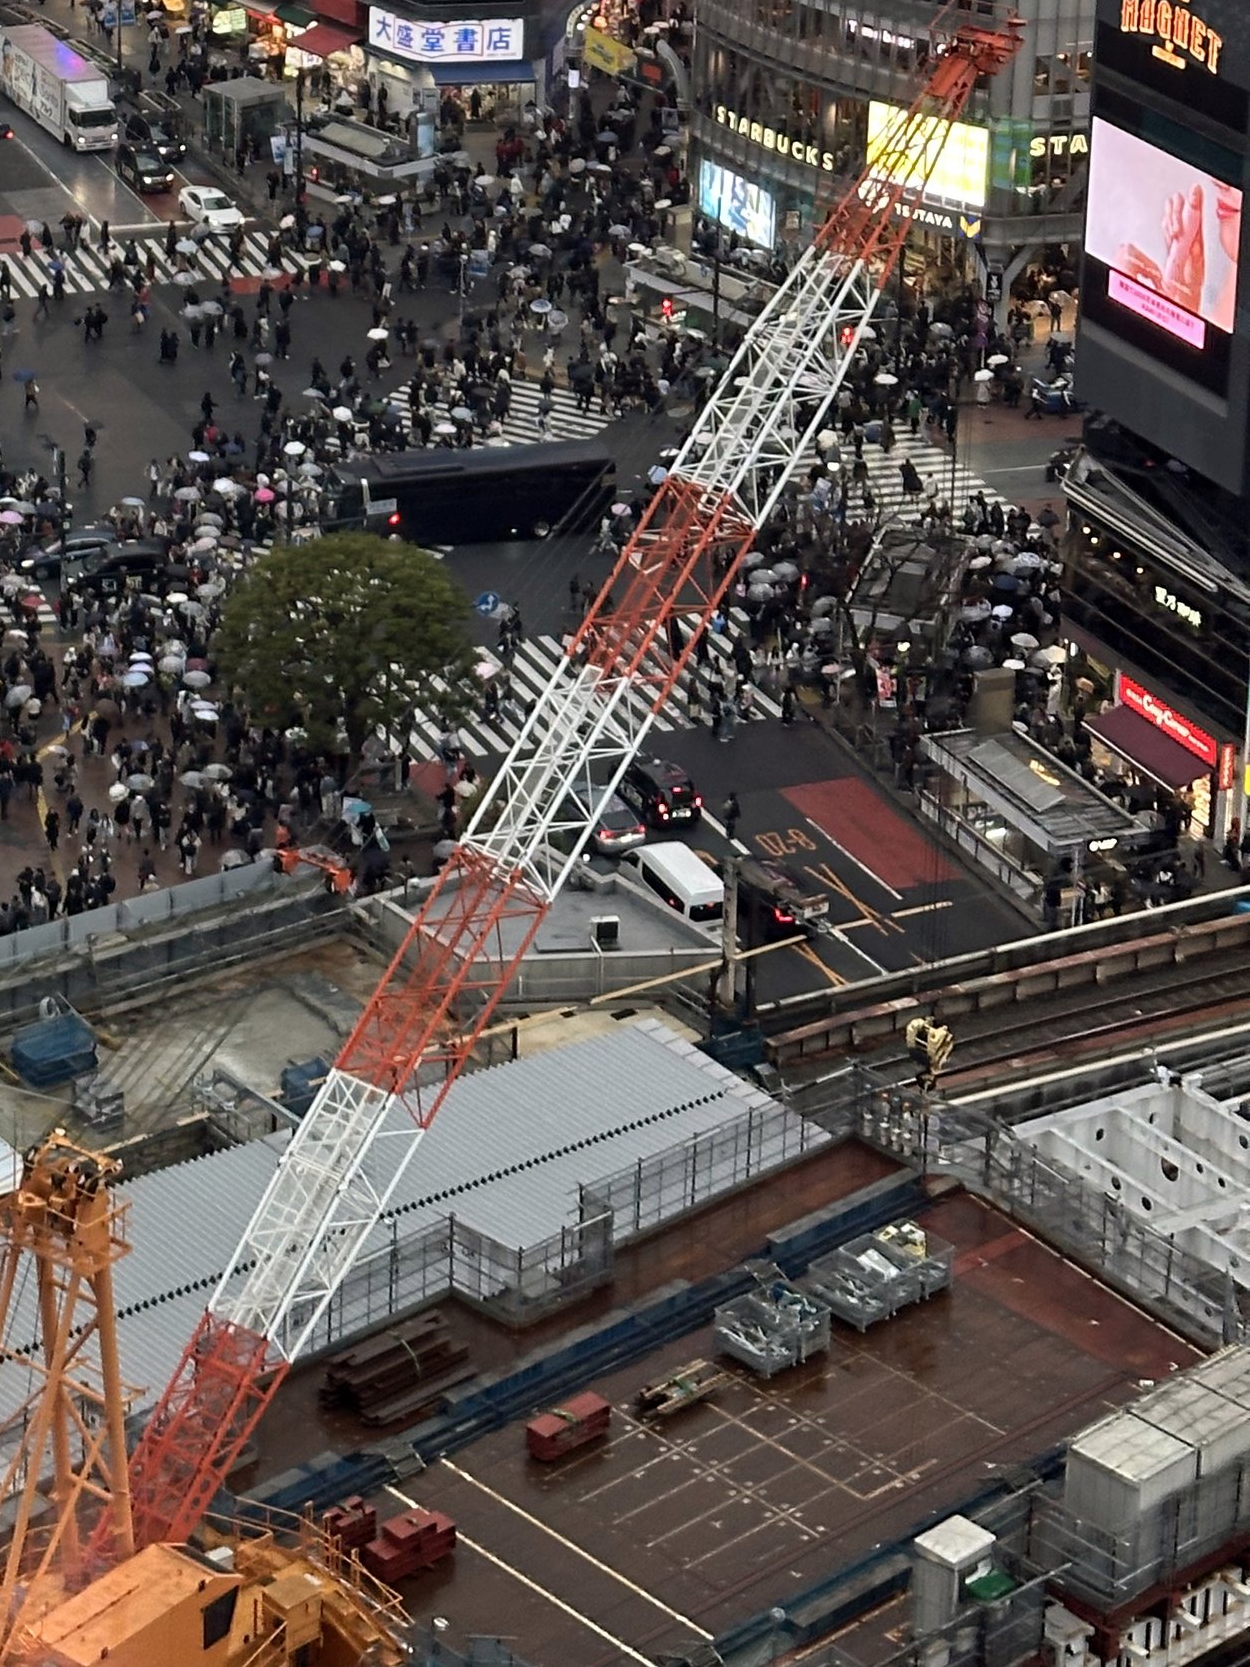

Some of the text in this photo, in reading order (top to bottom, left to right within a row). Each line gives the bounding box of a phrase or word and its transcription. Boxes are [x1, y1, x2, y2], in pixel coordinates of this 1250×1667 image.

[376, 16, 512, 53] 大盛堂書店
[716, 105, 834, 171] STARBUCKS
[1030, 134, 1088, 157] STA
